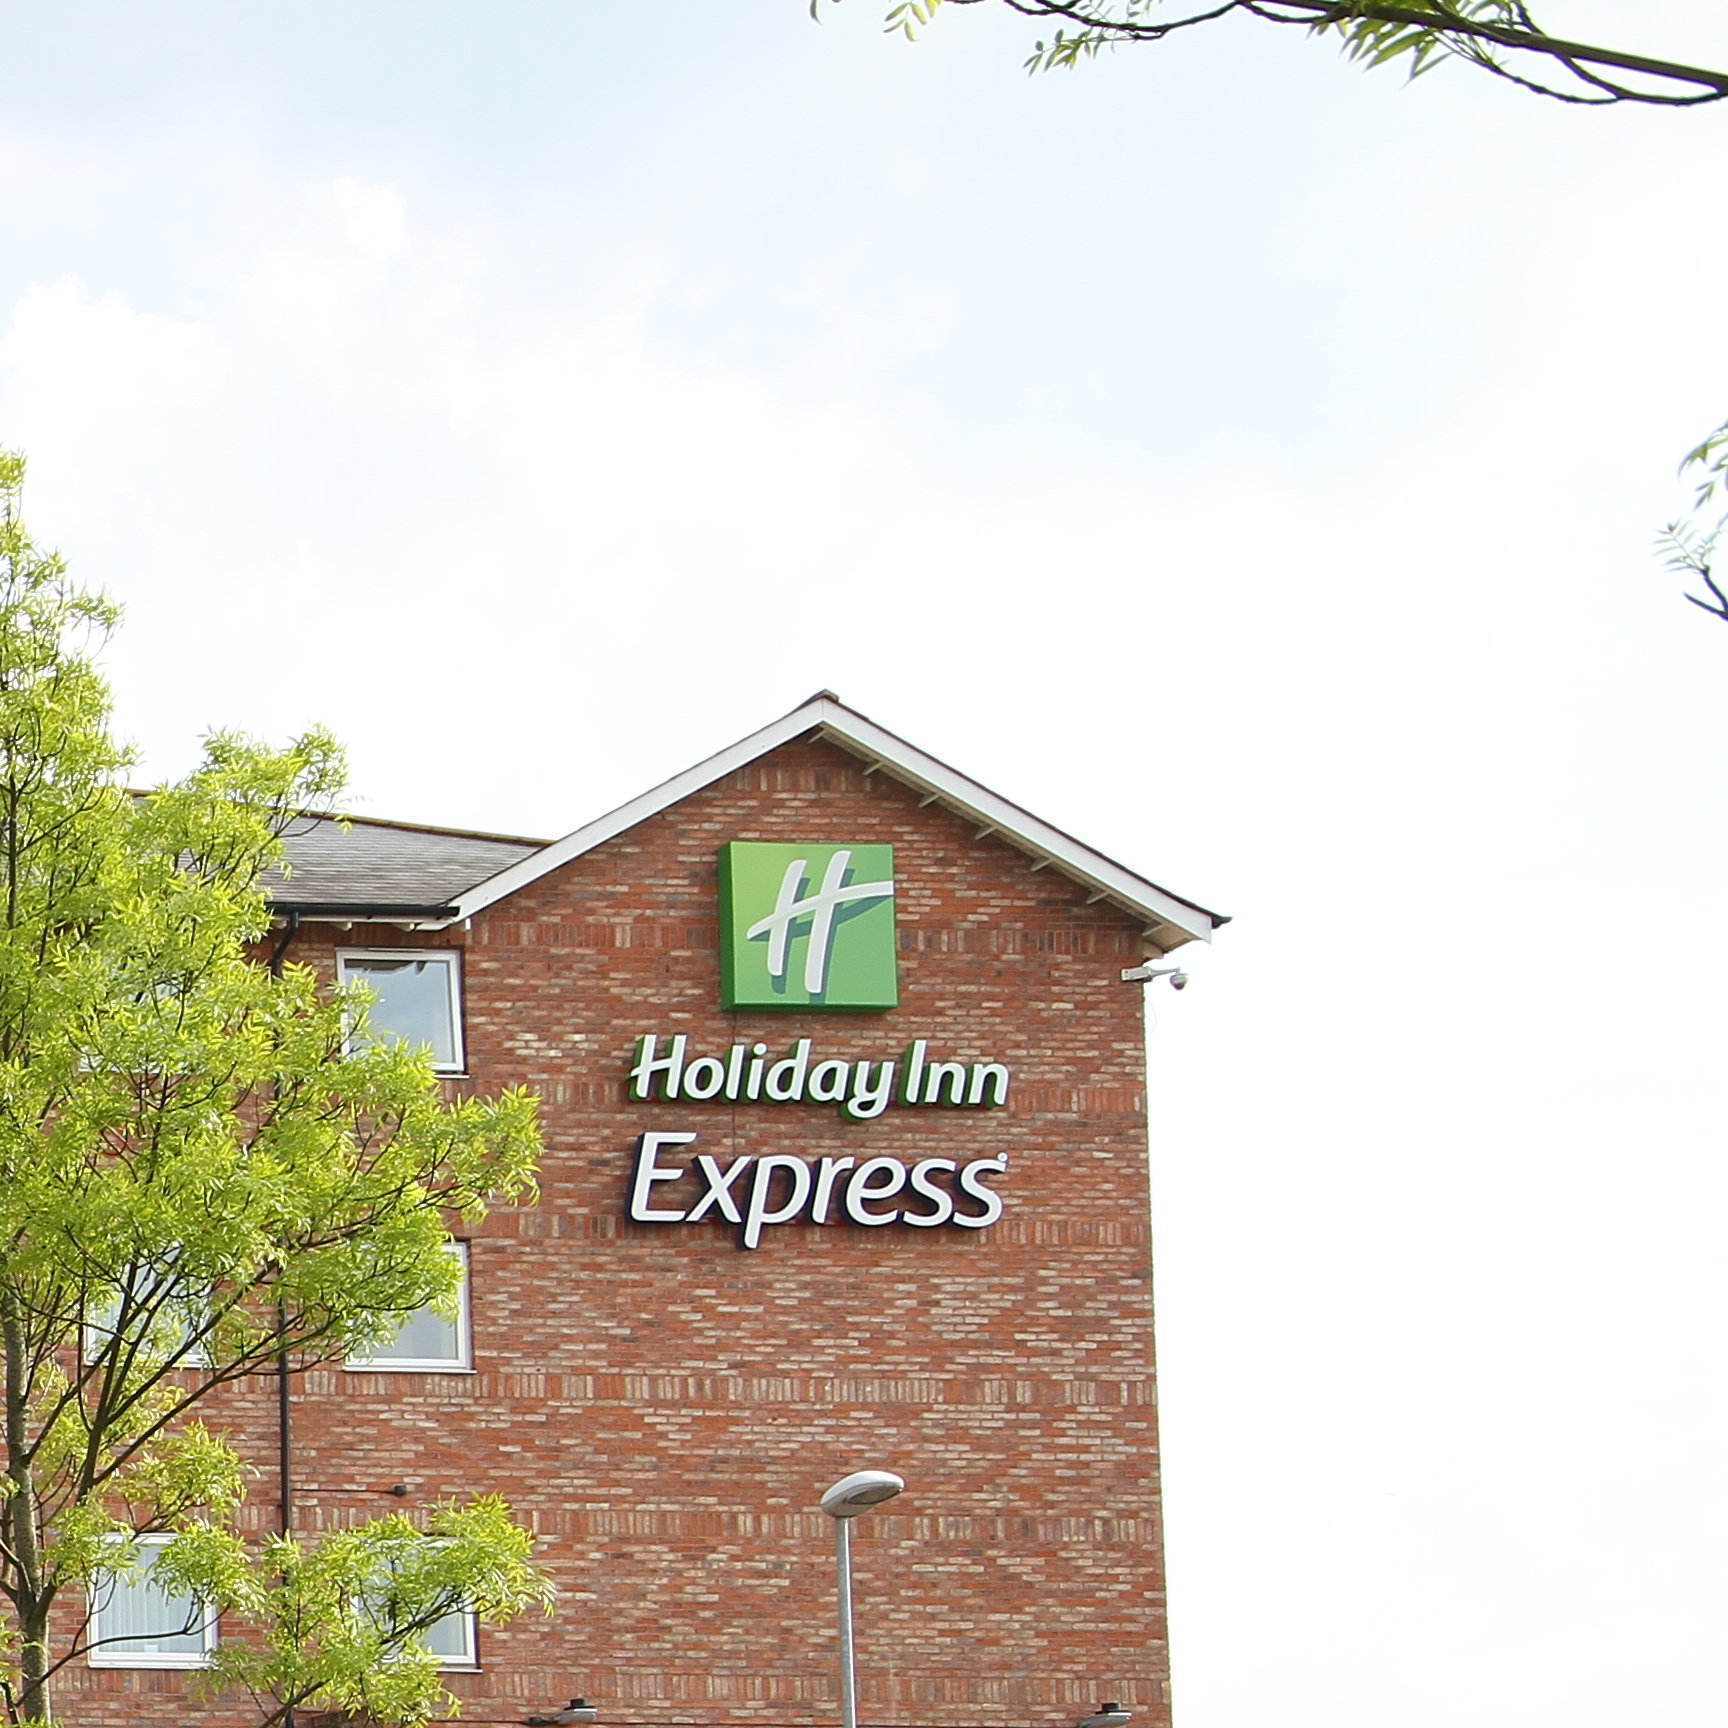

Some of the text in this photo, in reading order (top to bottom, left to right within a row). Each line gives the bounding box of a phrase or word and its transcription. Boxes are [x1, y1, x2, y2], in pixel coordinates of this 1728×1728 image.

[628, 1033, 1011, 1120] Holiday Inn
[629, 1130, 1008, 1250] Express
